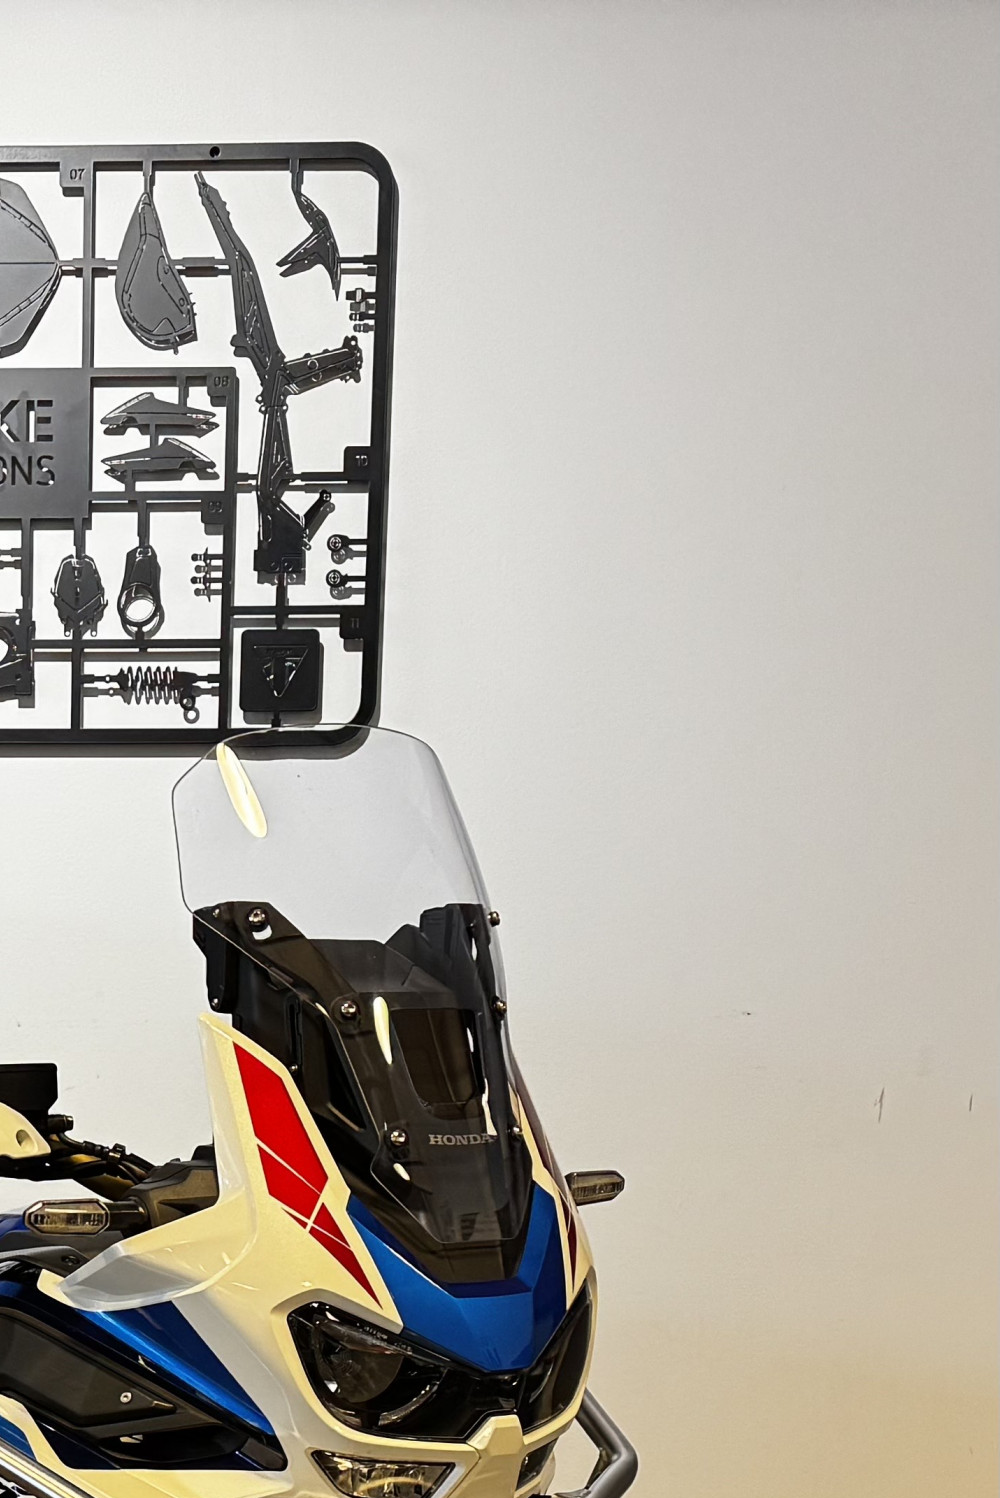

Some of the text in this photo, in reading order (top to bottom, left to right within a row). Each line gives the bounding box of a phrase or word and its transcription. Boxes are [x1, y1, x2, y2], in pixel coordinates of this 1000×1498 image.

[69, 168, 86, 181] 07
[213, 375, 229, 388] 08
[428, 1133, 496, 1146] HONDA
